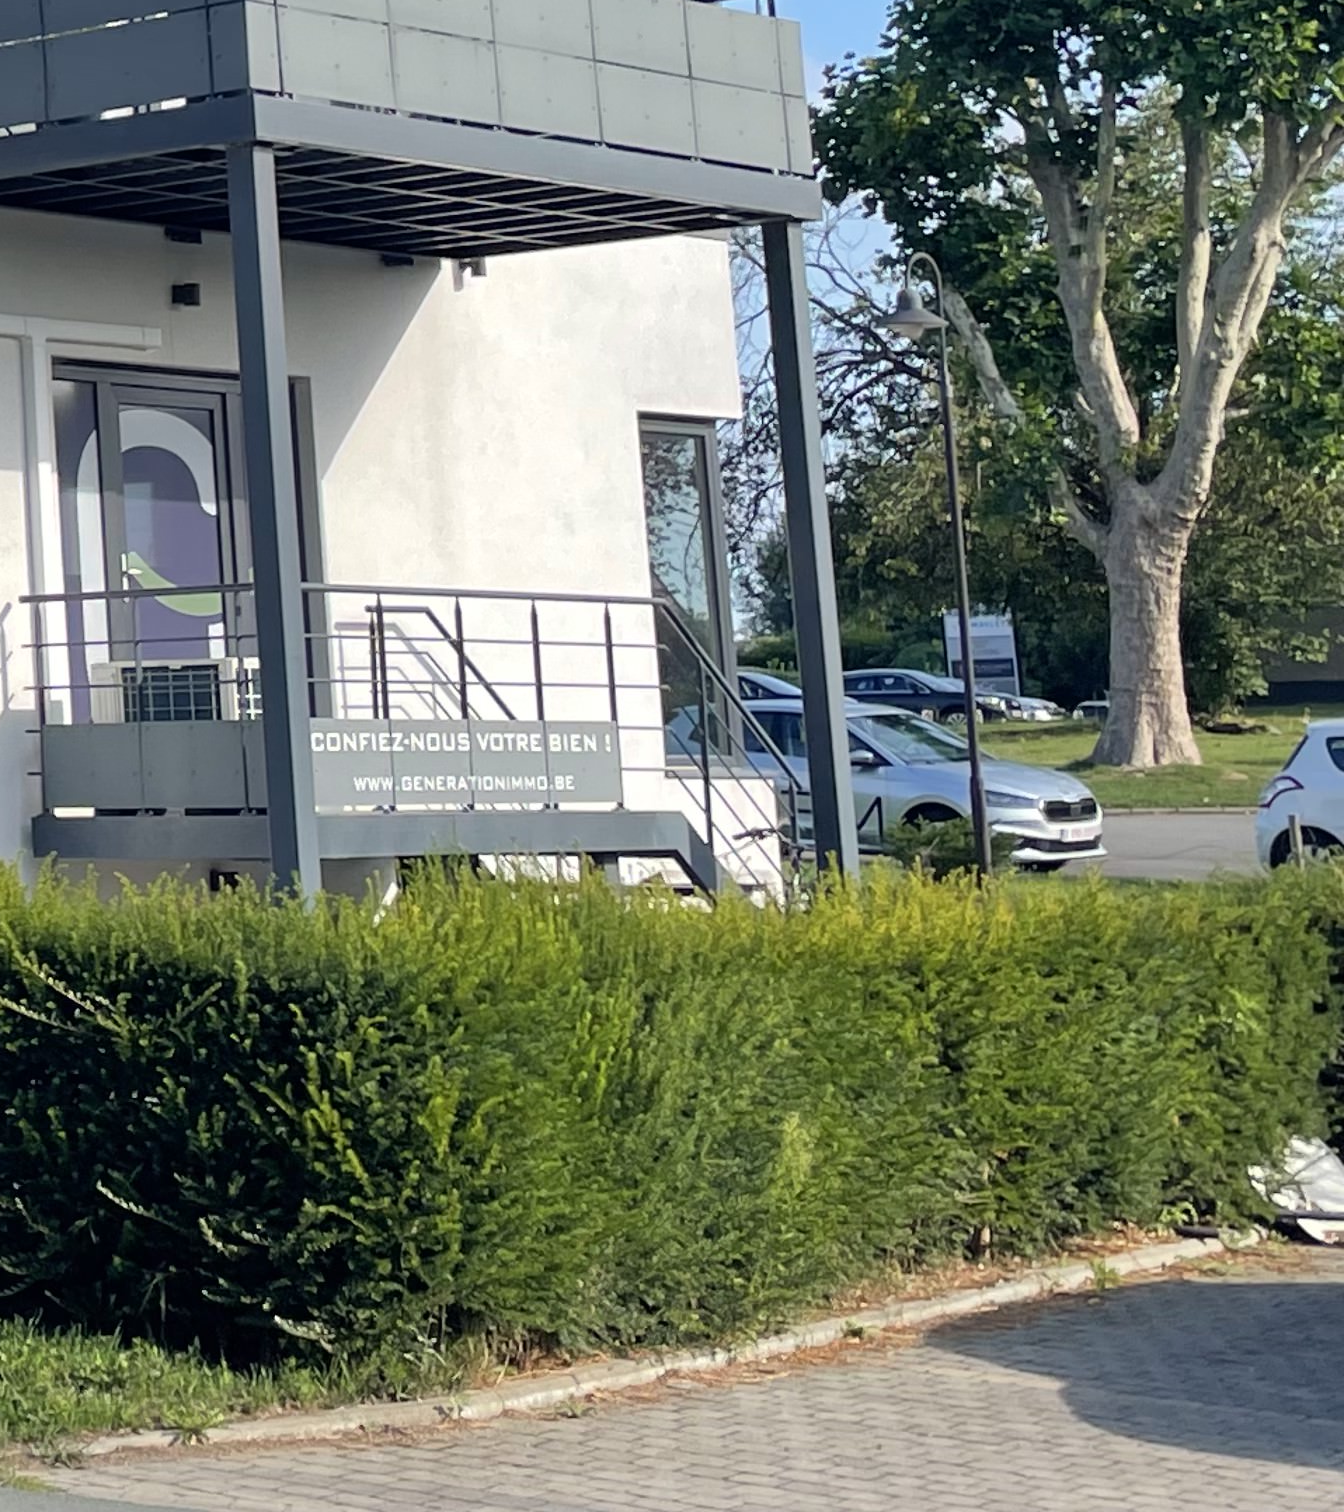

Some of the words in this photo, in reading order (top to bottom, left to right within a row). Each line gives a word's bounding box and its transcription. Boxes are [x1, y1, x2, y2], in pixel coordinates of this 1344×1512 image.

[310, 732, 471, 752] CONFIEZ-NOUS
[476, 733, 543, 752] VOTRE
[549, 733, 598, 752] BIEN
[353, 775, 576, 792] WWW.GENERATIONIMMO.BE
